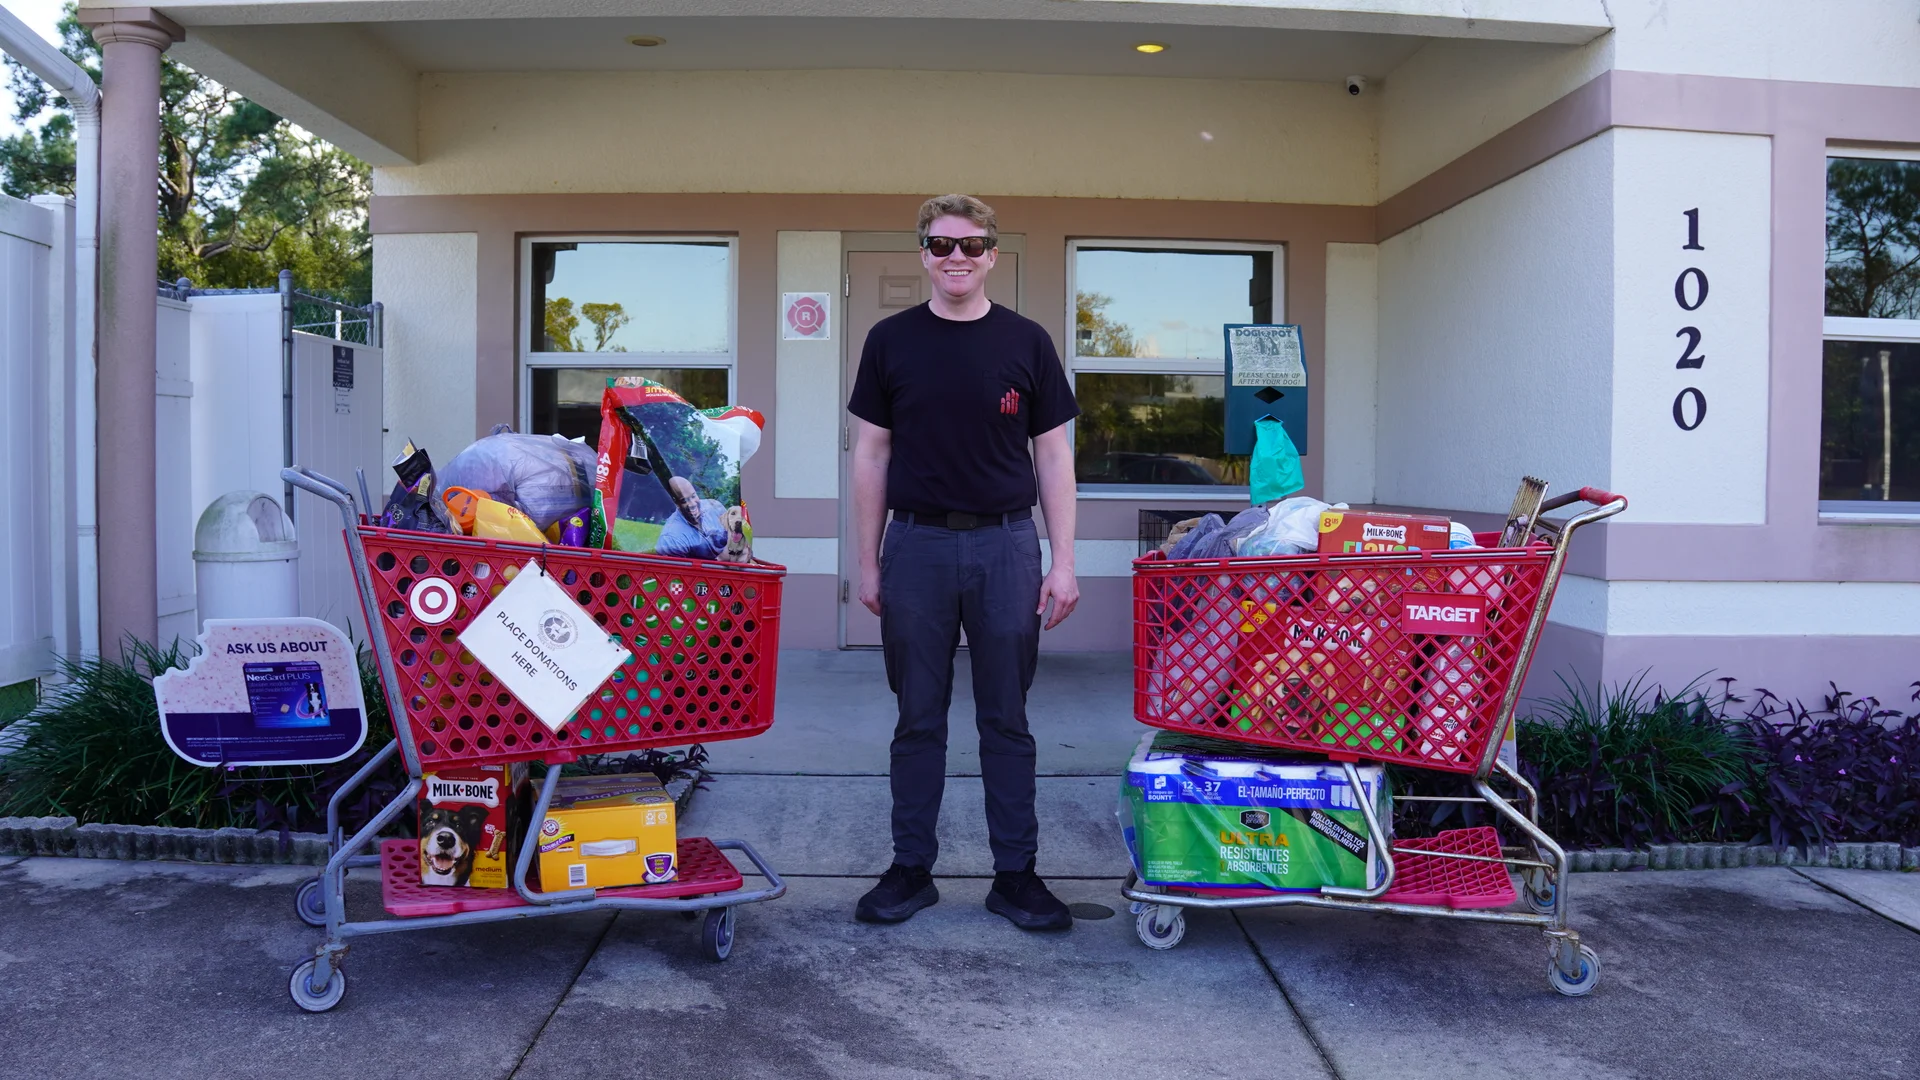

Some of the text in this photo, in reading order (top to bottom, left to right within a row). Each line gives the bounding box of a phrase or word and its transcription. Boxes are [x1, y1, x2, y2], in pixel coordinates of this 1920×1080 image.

[802, 311, 811, 321] R
[1672, 207, 1709, 431] 1020
[1323, 518, 1331, 528] 8
[1406, 604, 1480, 623] TARGET
[226, 641, 328, 654] ASK US ABOUT
[496, 611, 527, 642] PLACE
[524, 639, 578, 692] DONATIONS
[511, 651, 538, 678] HERE
[246, 672, 311, 681] NexGard PLUS
[1182, 781, 1193, 790] 12
[1204, 781, 1221, 792] 37
[1309, 817, 1360, 853] INDIVIDUALMENTE
[1311, 810, 1366, 848] ROLLOS ENVUELTOS
[1220, 831, 1290, 847] ULTRA
[1220, 846, 1290, 862] RESISTENTES
[1227, 861, 1289, 875] ABSORBENTES
